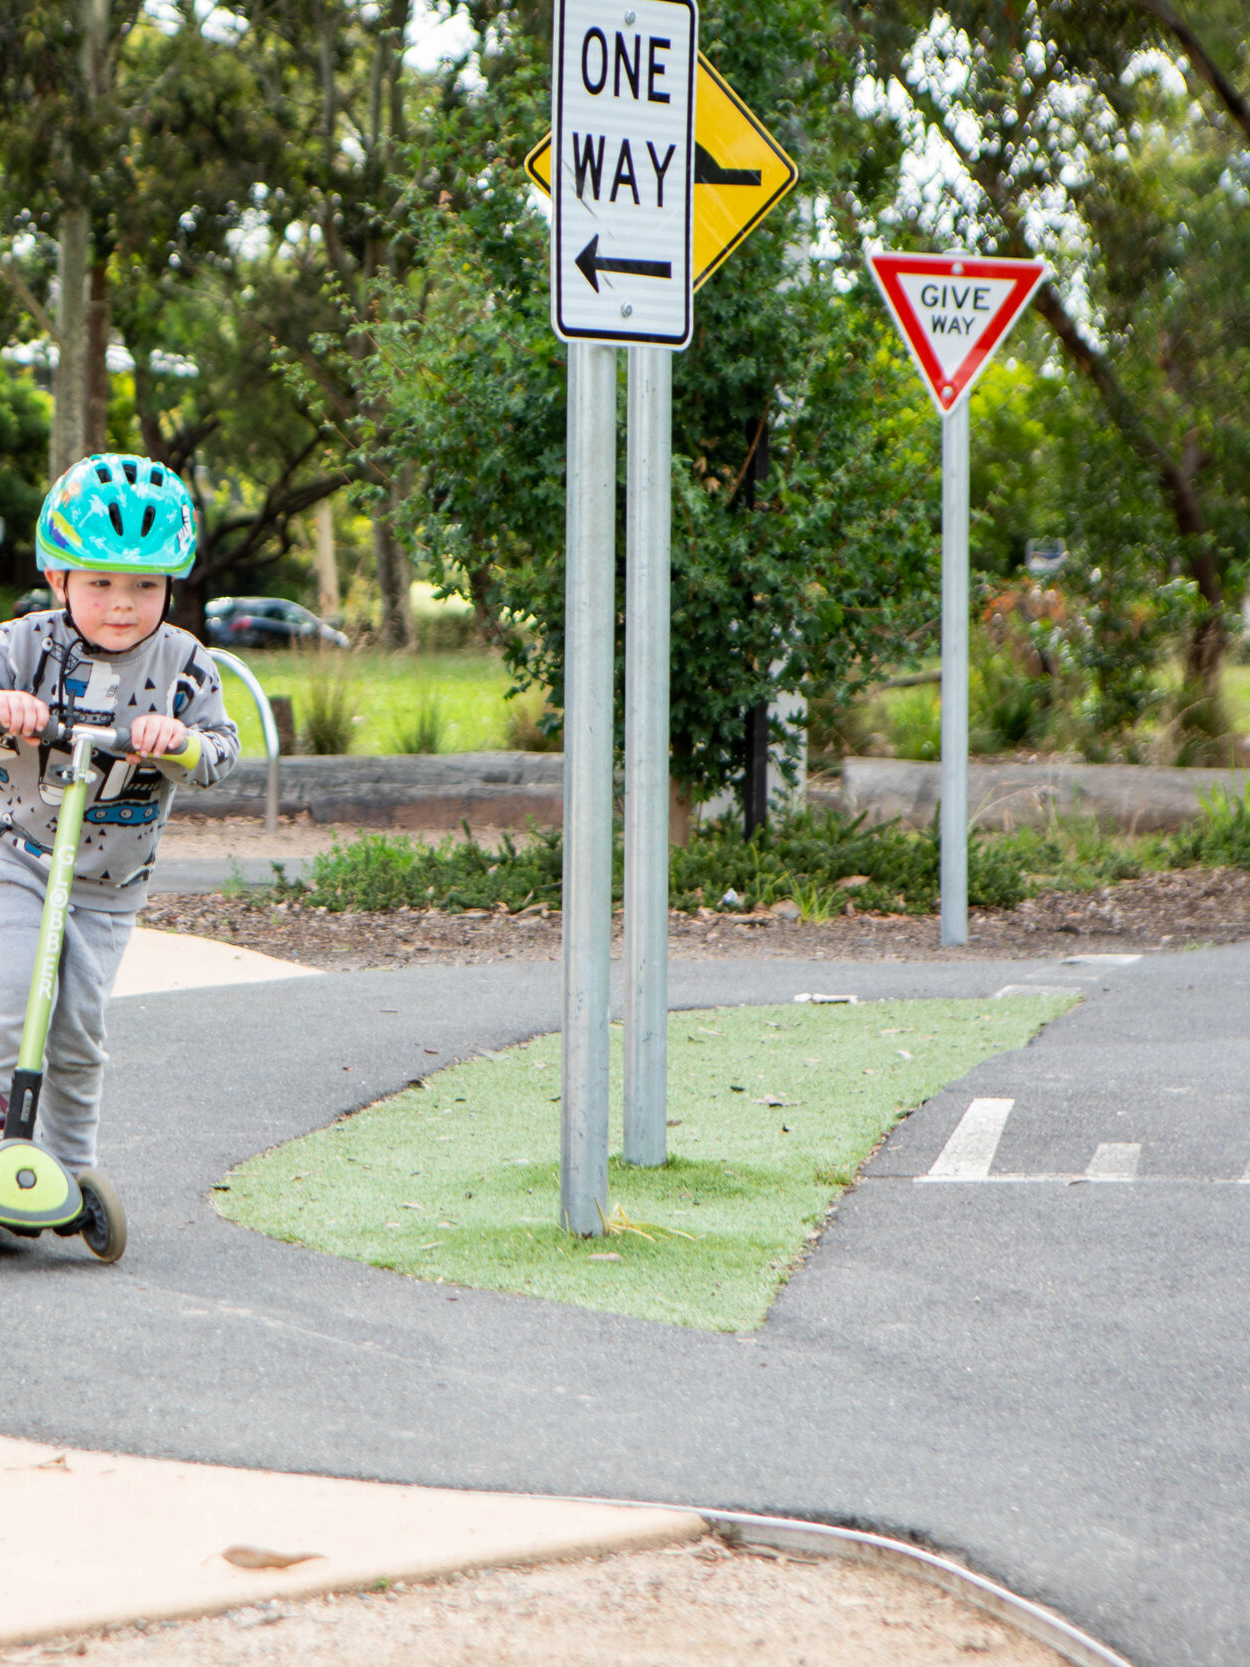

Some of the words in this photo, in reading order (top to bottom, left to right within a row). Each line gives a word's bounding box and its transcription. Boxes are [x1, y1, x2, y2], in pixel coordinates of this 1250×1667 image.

[581, 26, 671, 104] ONE
[572, 131, 677, 208] WAY
[920, 283, 991, 311] GIVE
[931, 314, 976, 335] WAY
[37, 843, 76, 1000] GLOBBER
